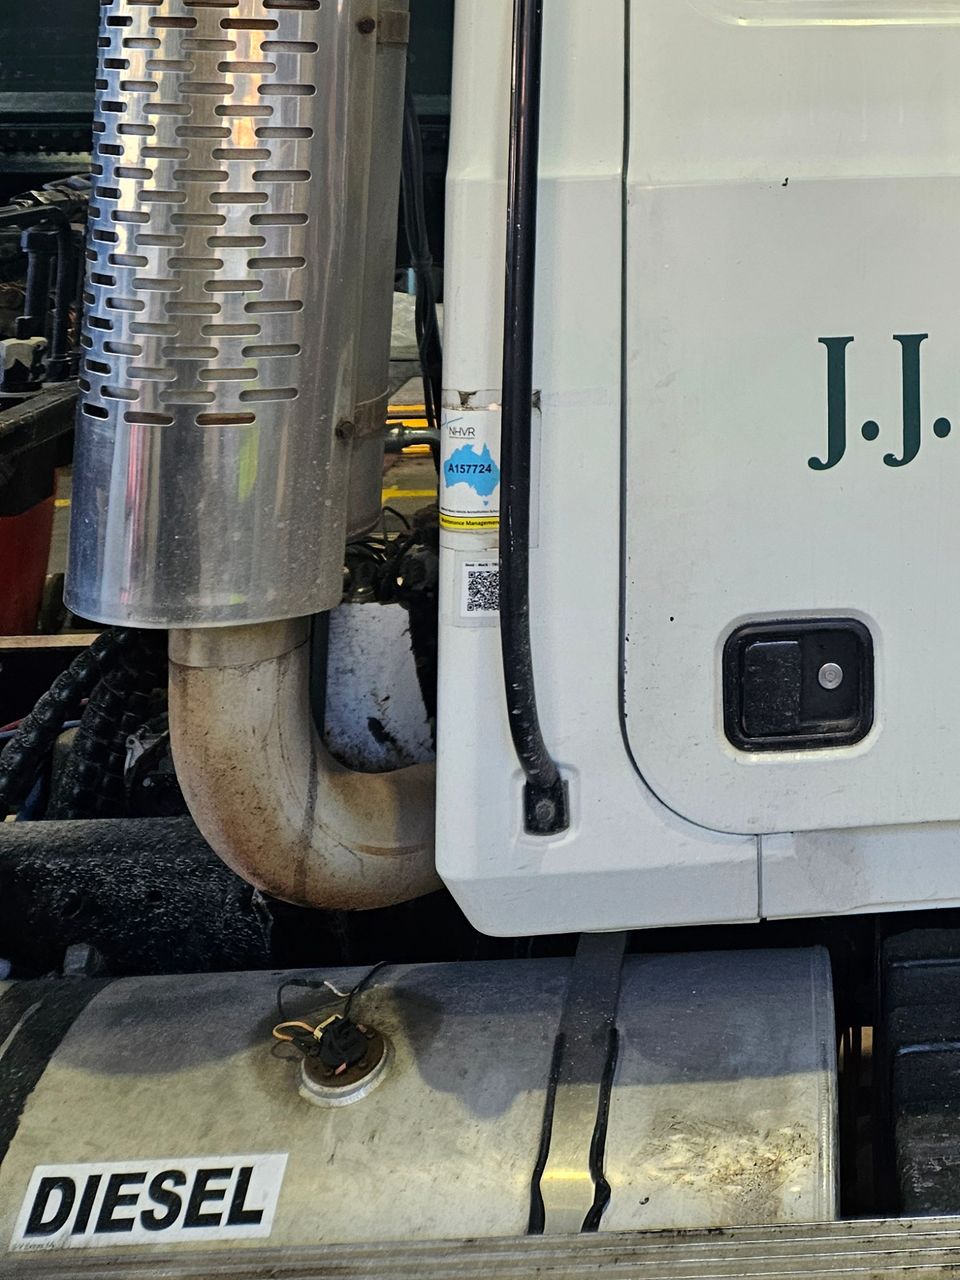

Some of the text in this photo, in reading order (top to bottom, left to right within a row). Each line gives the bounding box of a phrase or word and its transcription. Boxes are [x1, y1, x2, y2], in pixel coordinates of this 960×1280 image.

[808, 333, 951, 470] J.J.
[448, 427, 476, 437] NHVR
[447, 463, 492, 474] A157724
[23, 1166, 264, 1238] DIESEL
